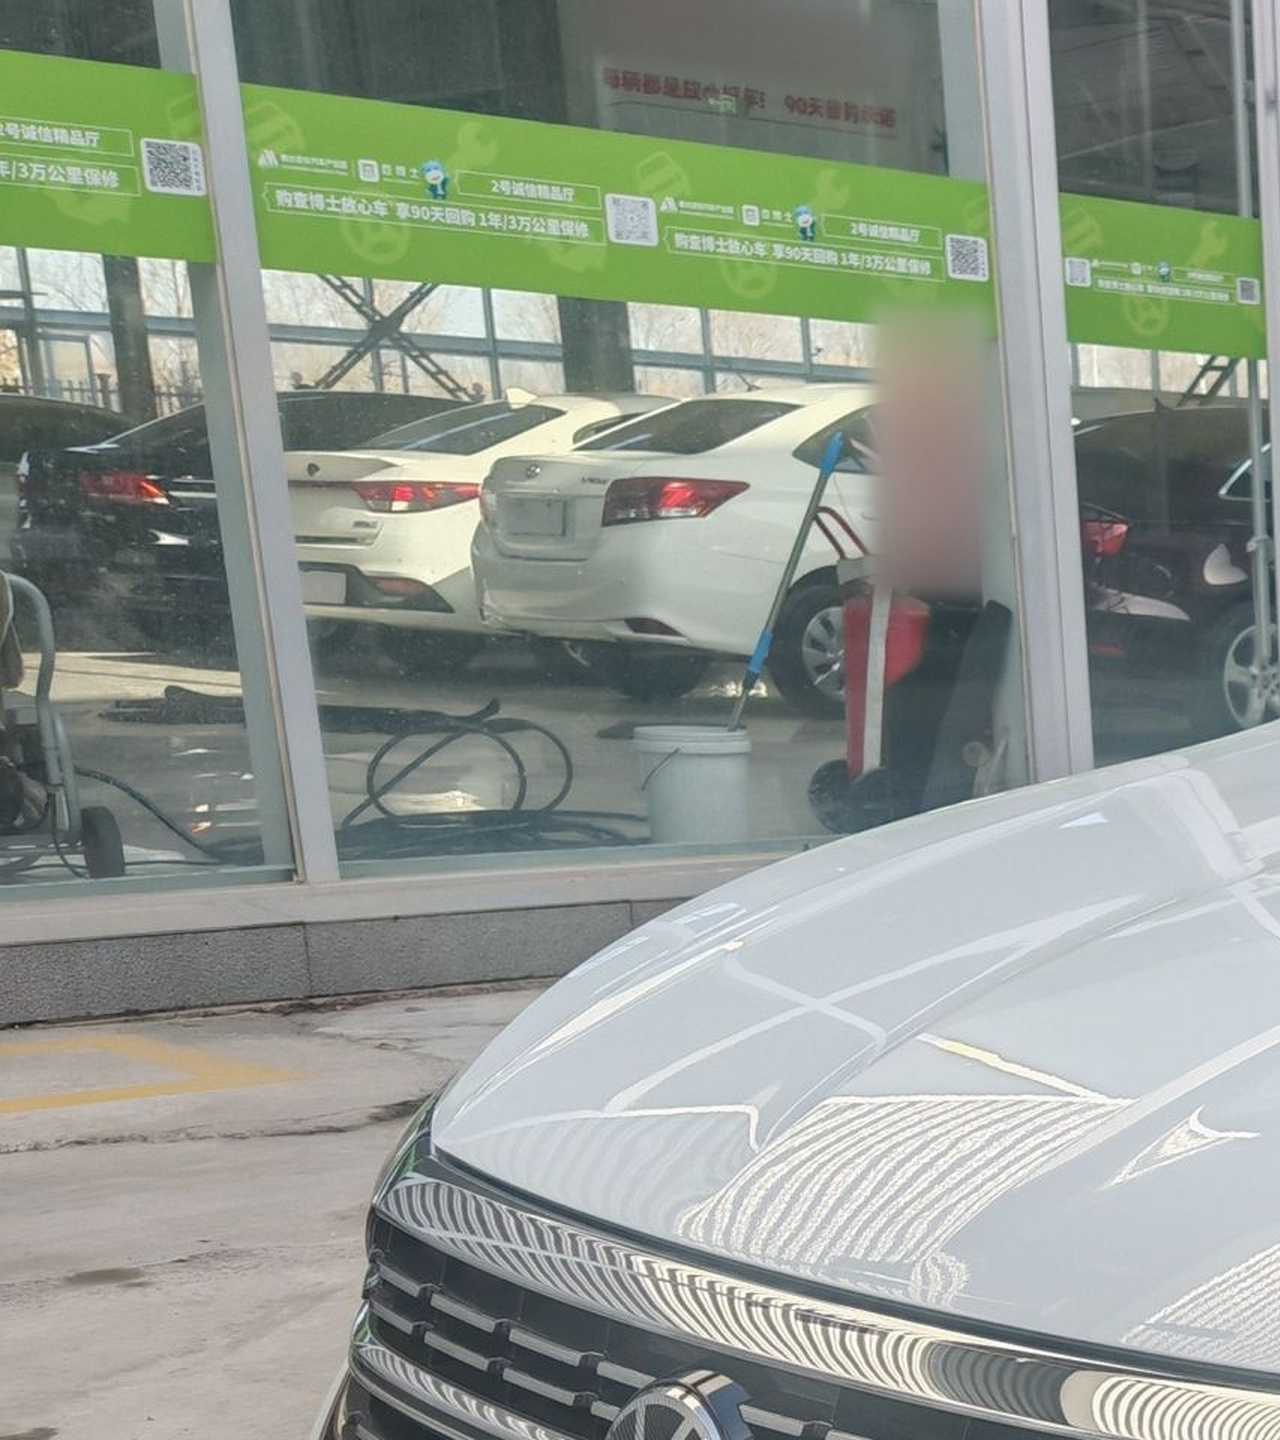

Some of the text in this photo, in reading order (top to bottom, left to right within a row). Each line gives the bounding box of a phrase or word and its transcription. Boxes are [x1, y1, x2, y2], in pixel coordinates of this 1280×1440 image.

[491, 179, 576, 202] 2号诚信精品厅
[275, 189, 389, 217] 购查博士放心车
[395, 201, 476, 227] 享90天回购
